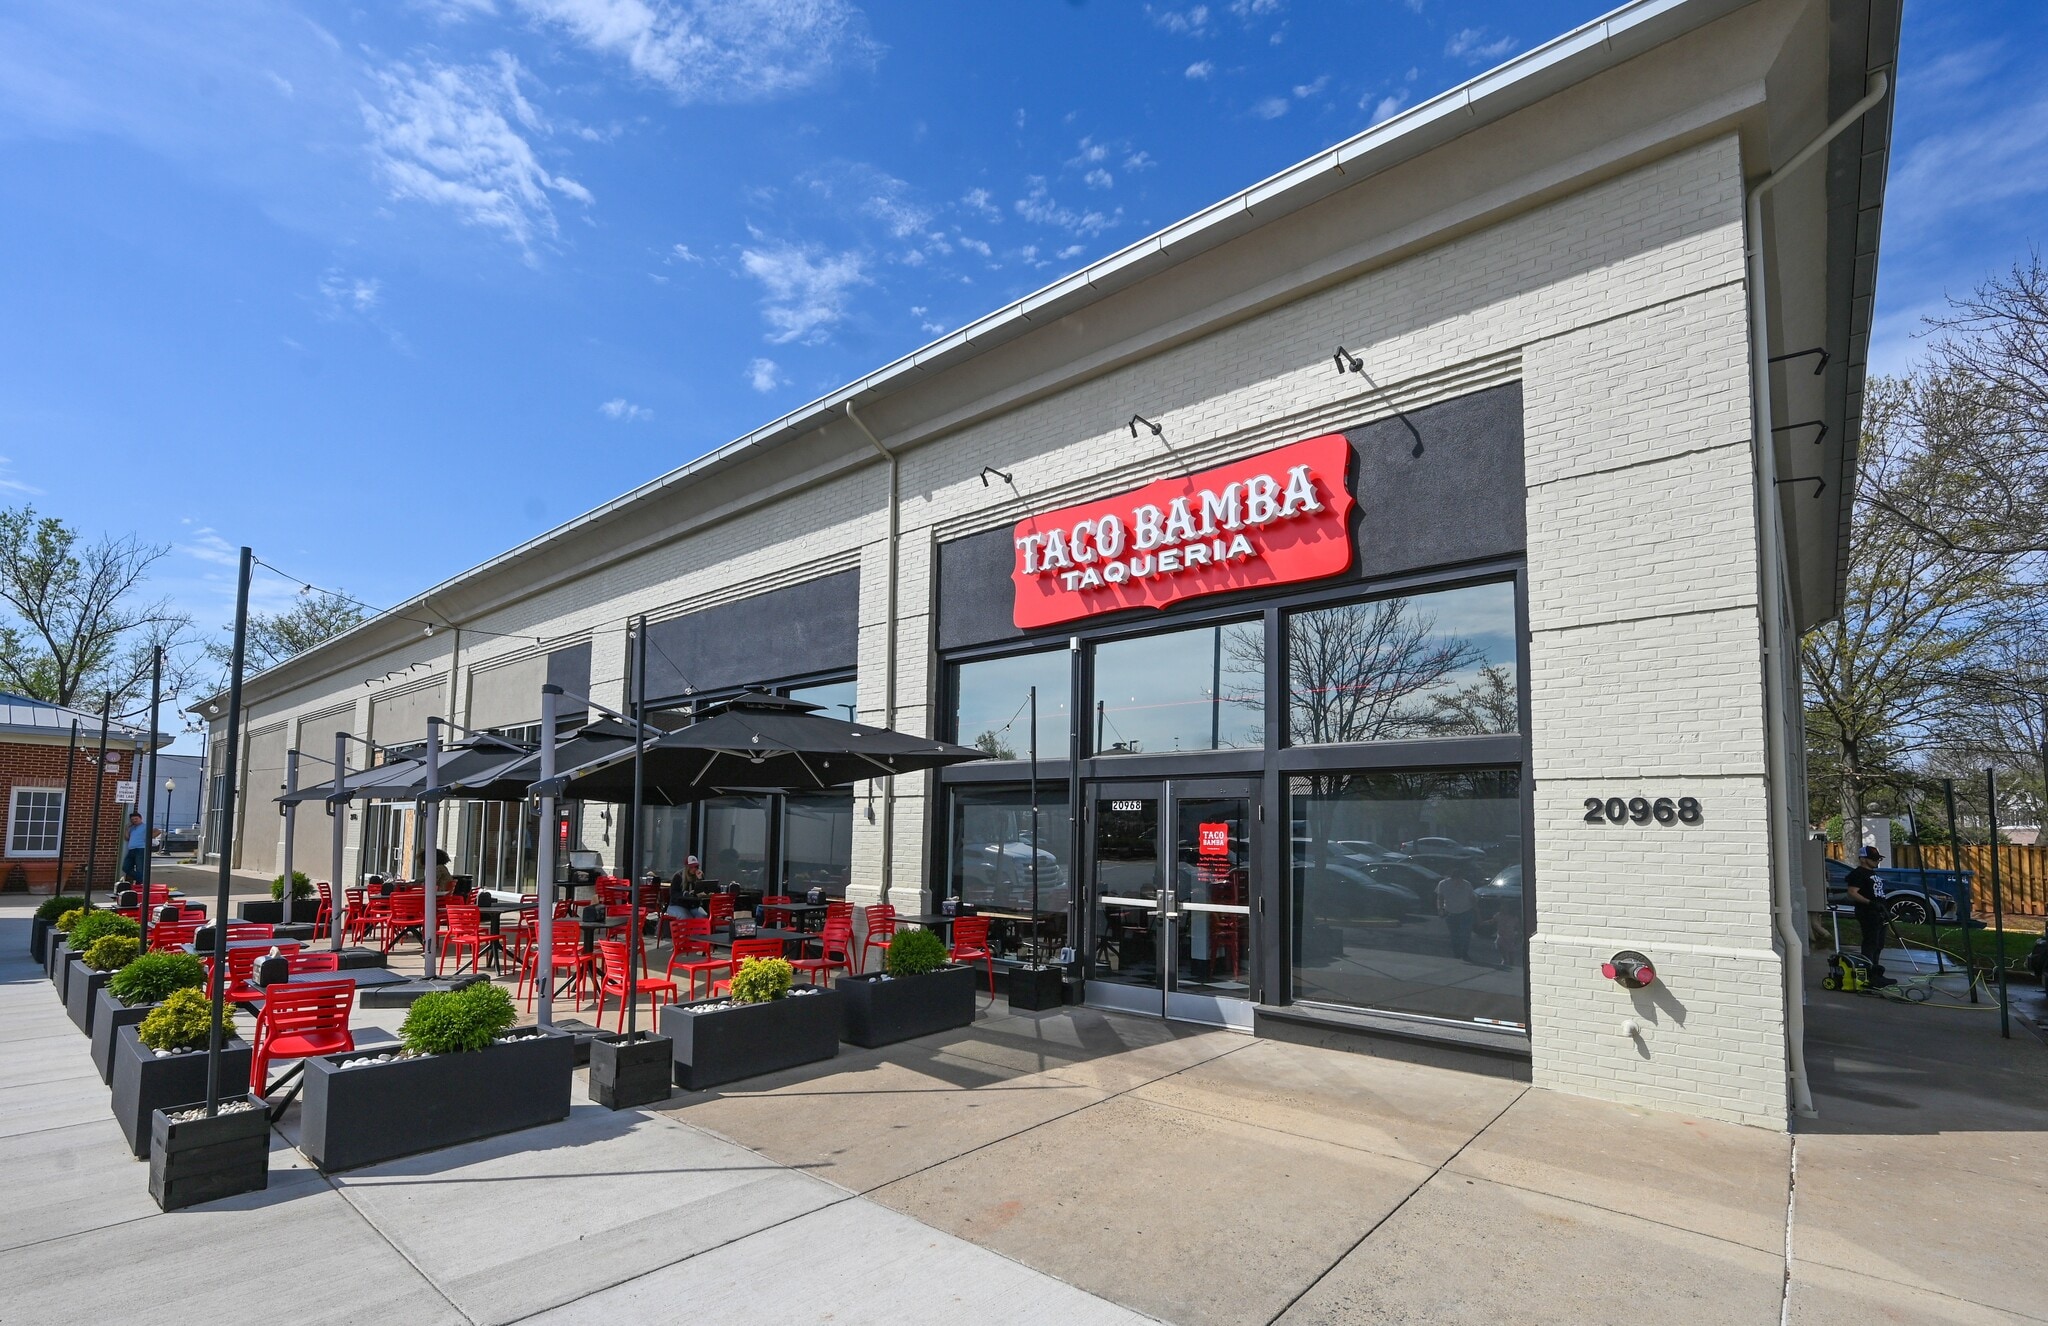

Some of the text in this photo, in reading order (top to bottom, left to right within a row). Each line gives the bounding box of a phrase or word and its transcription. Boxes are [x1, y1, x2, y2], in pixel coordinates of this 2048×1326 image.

[1016, 464, 1324, 575] TACO BAMBA
[1060, 533, 1257, 591] TAQUERIA
[1113, 800, 1141, 810] 20968
[1583, 796, 1700, 823] 20968
[1203, 831, 1224, 839] TACO
